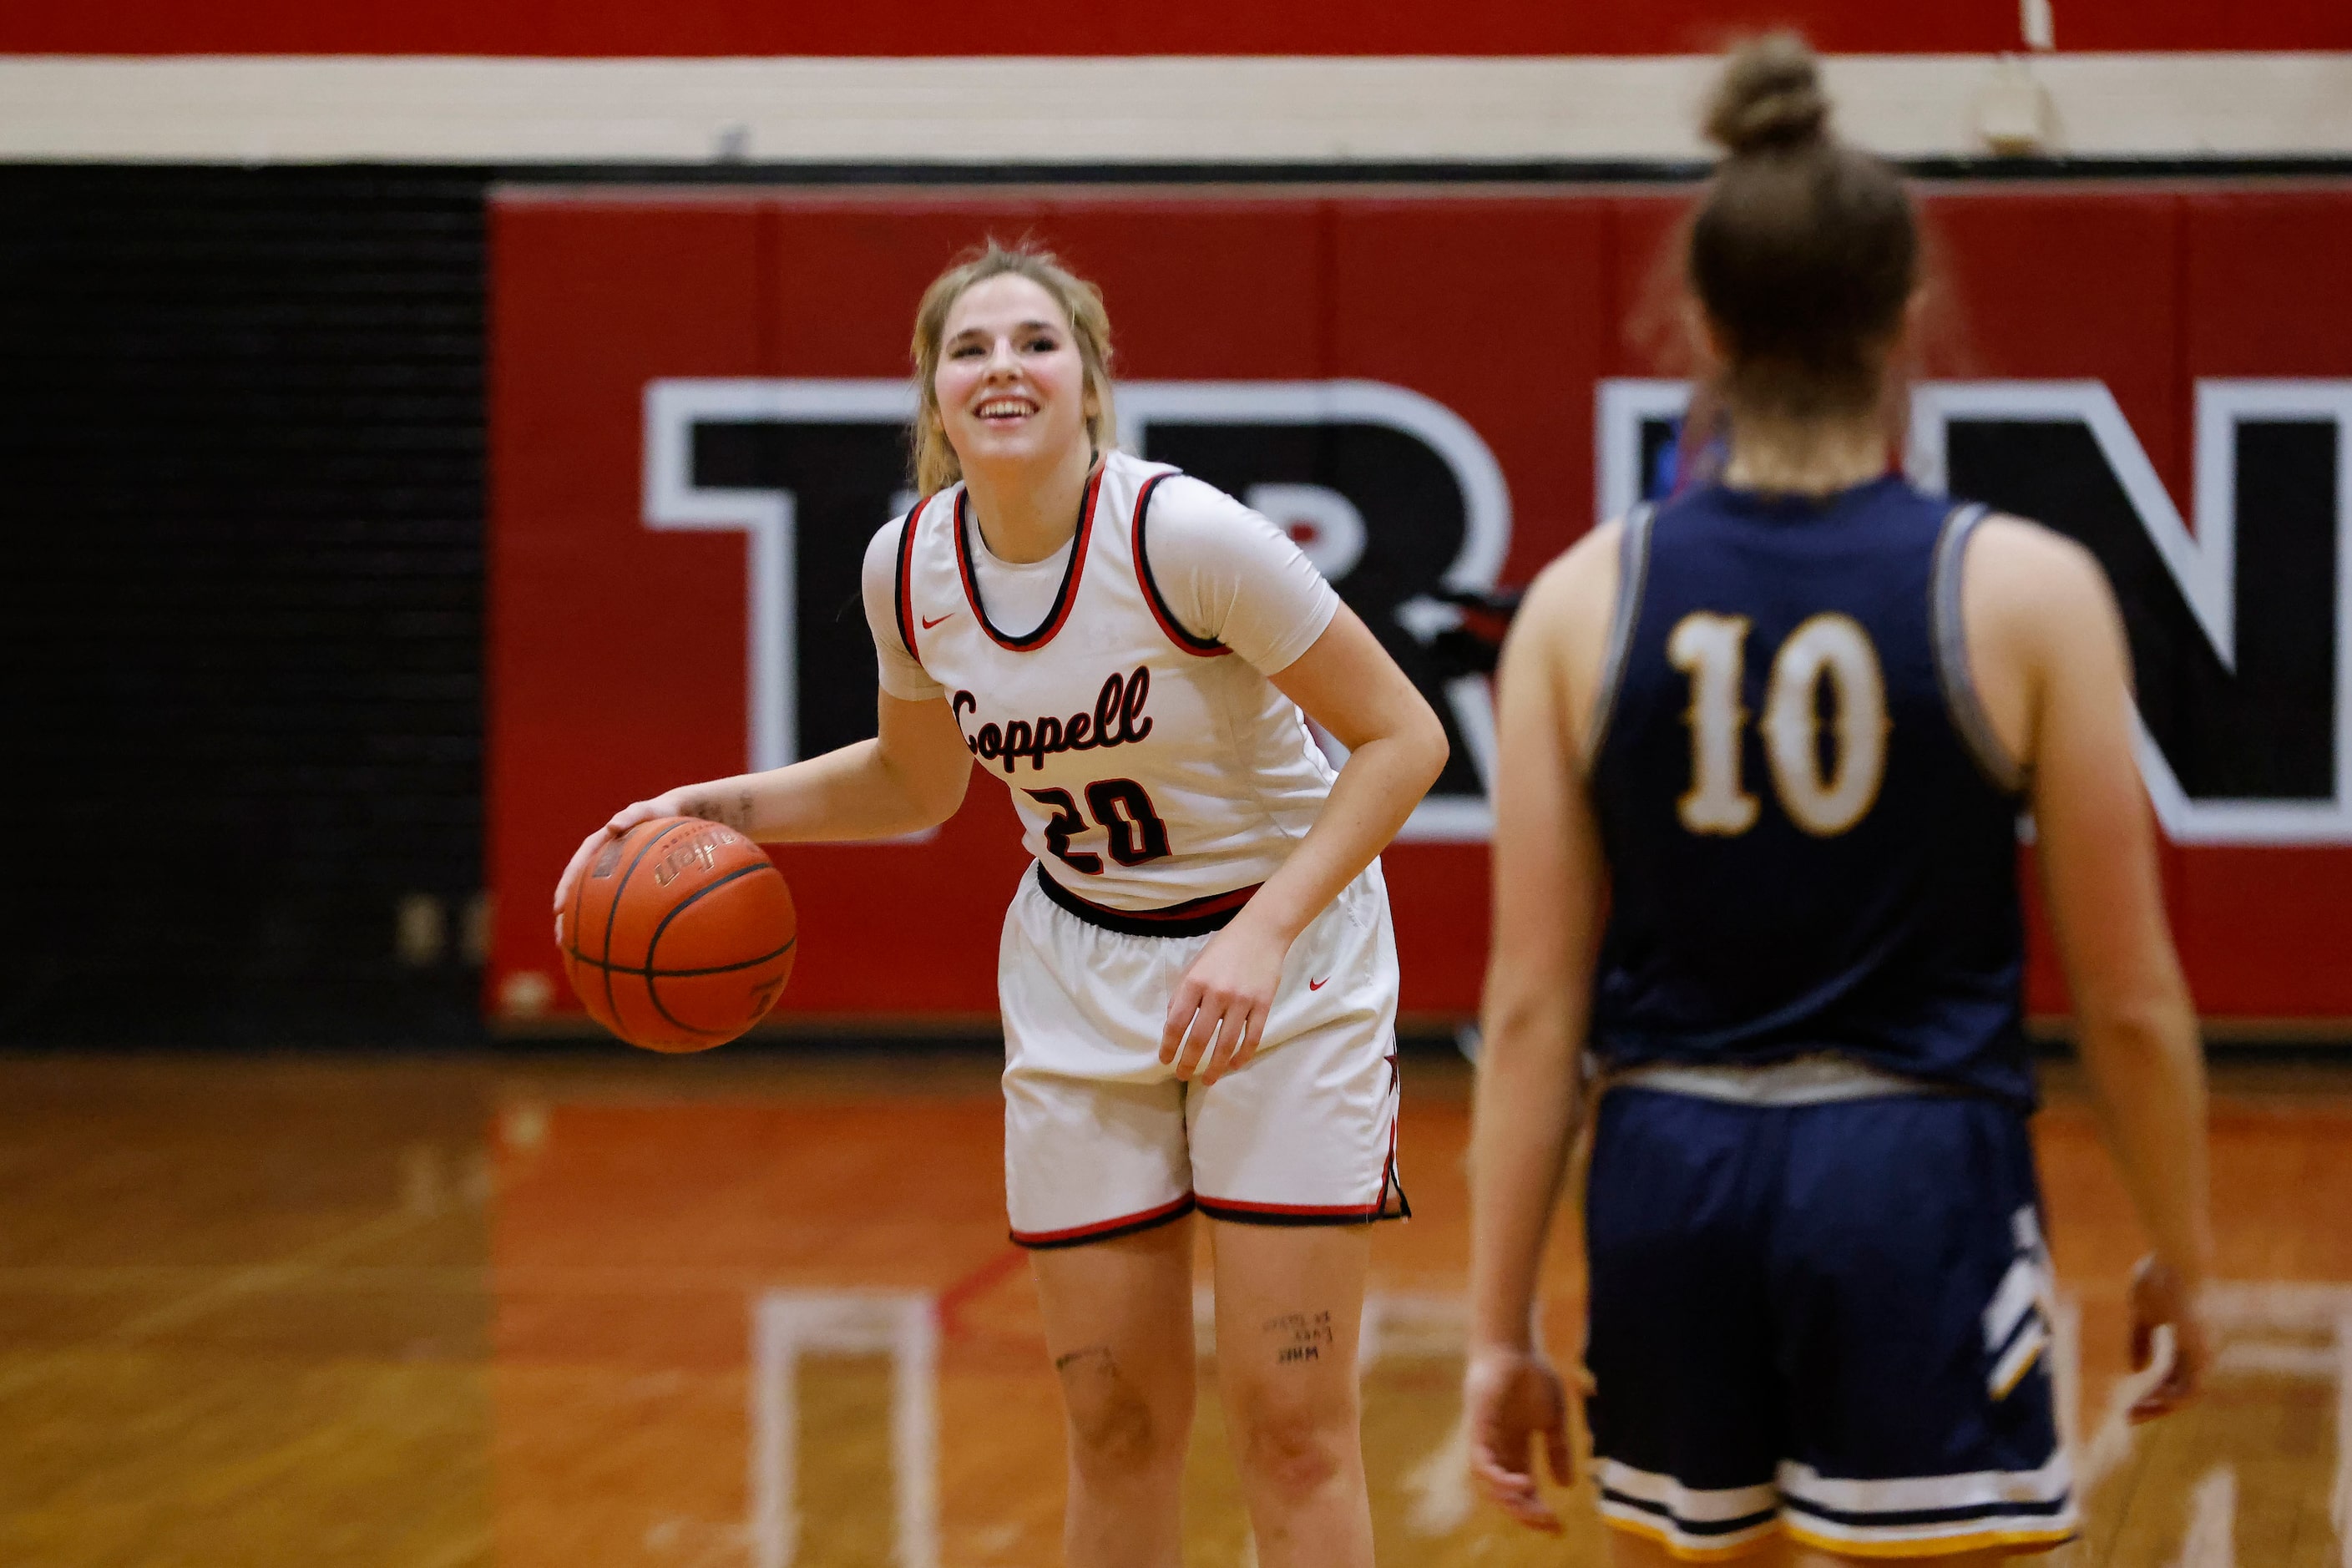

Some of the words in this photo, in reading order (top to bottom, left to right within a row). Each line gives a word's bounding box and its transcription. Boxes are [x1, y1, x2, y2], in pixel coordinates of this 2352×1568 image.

[953, 665, 1153, 773] Coppell
[1667, 610, 1894, 836] 10
[1019, 777, 1172, 876] 20
